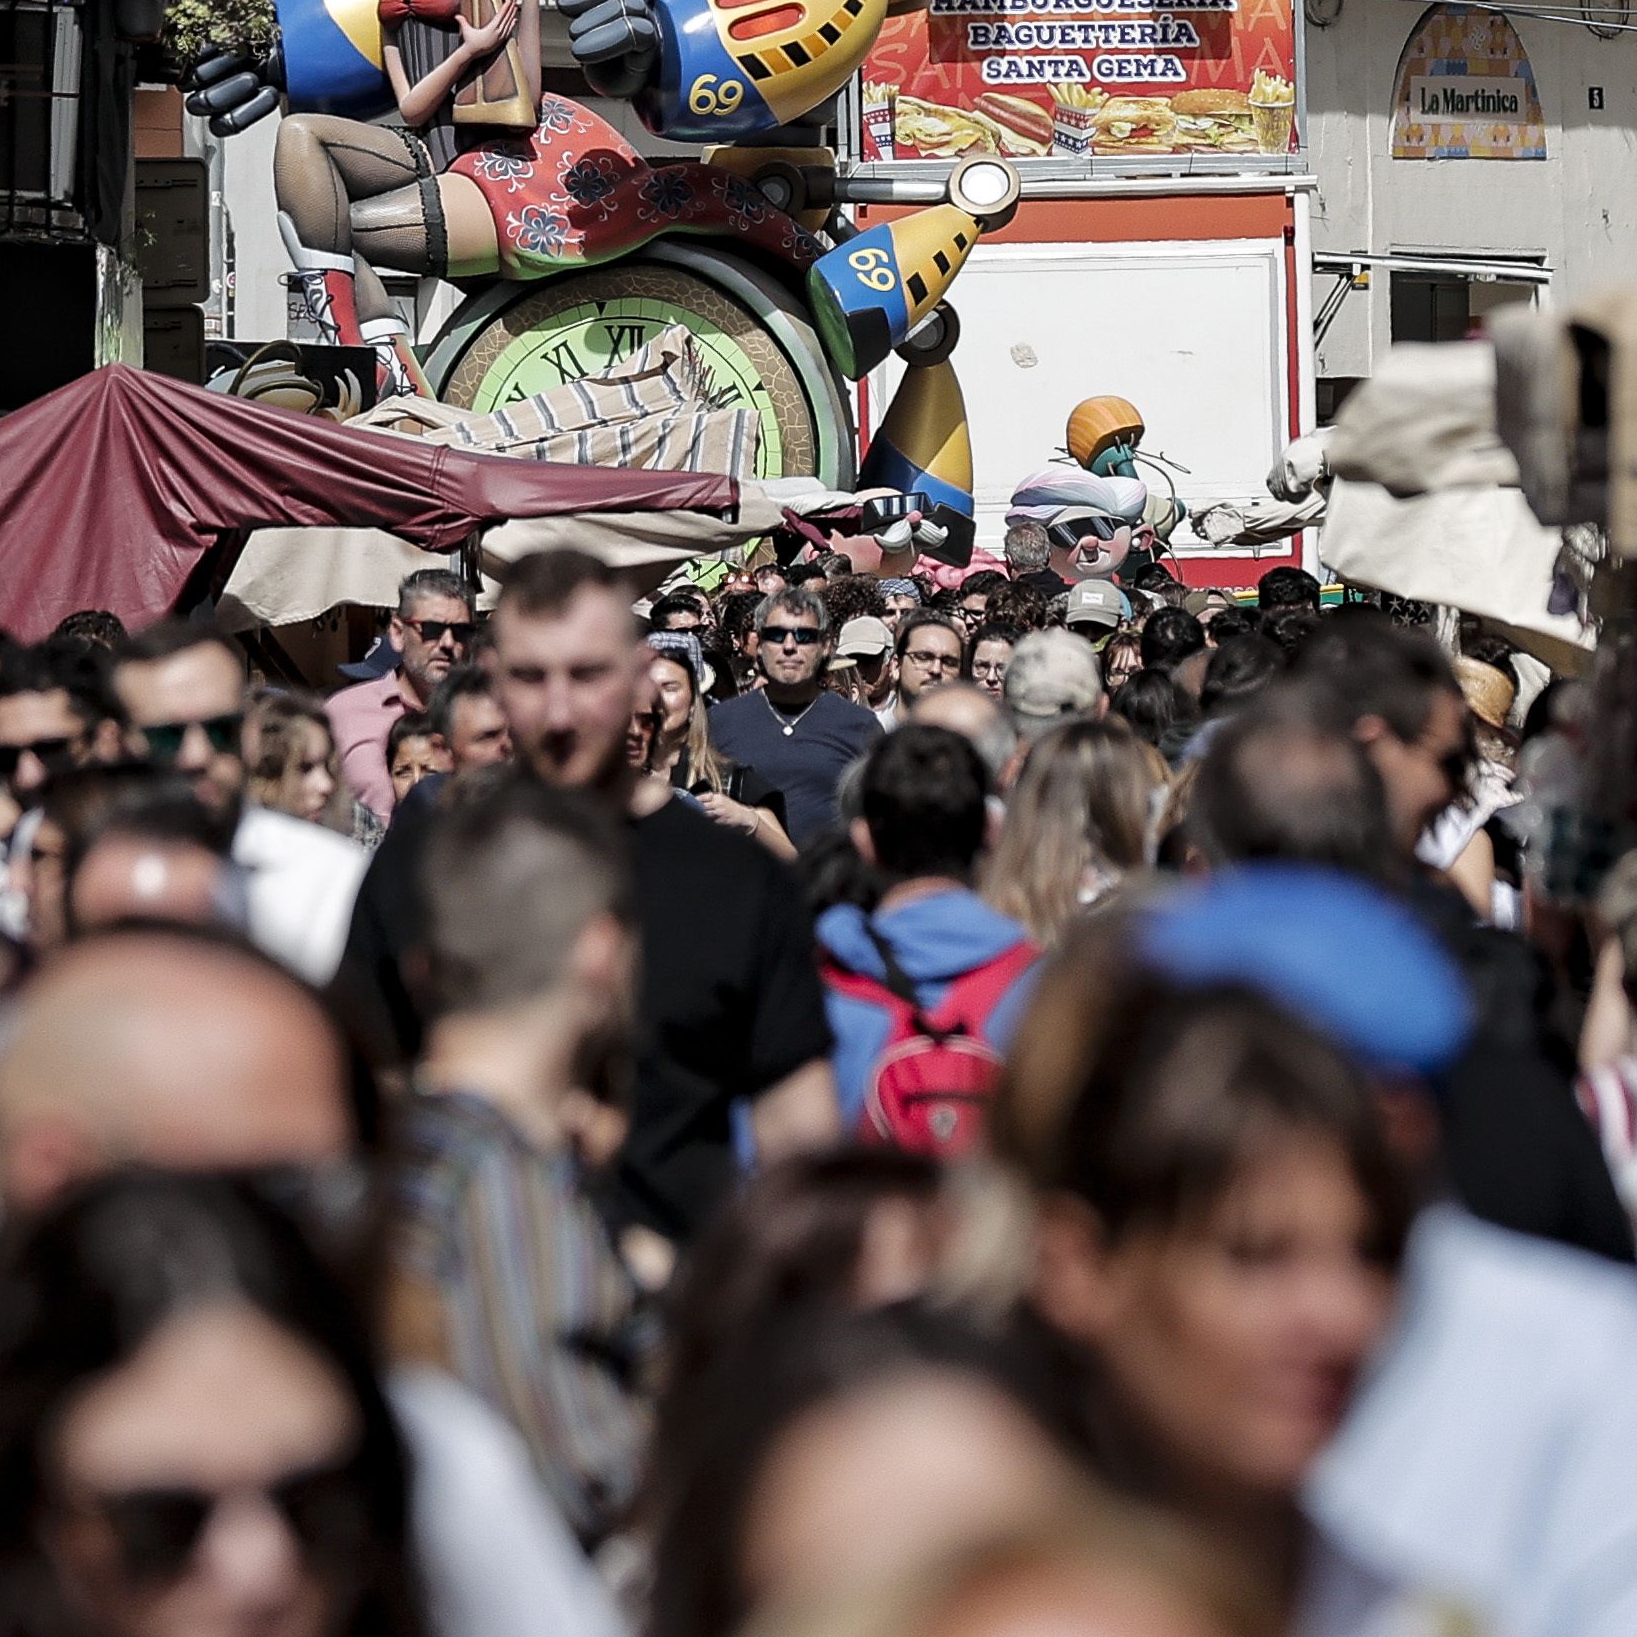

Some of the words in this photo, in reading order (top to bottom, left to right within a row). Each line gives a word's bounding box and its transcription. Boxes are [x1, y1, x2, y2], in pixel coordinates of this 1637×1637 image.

[968, 15, 1198, 47] BAGUETTERÍA
[985, 58, 1087, 80] SANTA
[1096, 56, 1183, 79] GEMA
[689, 73, 743, 116] 69
[1420, 87, 1440, 115] La
[1442, 88, 1519, 114] Martinica
[848, 248, 896, 292] 69
